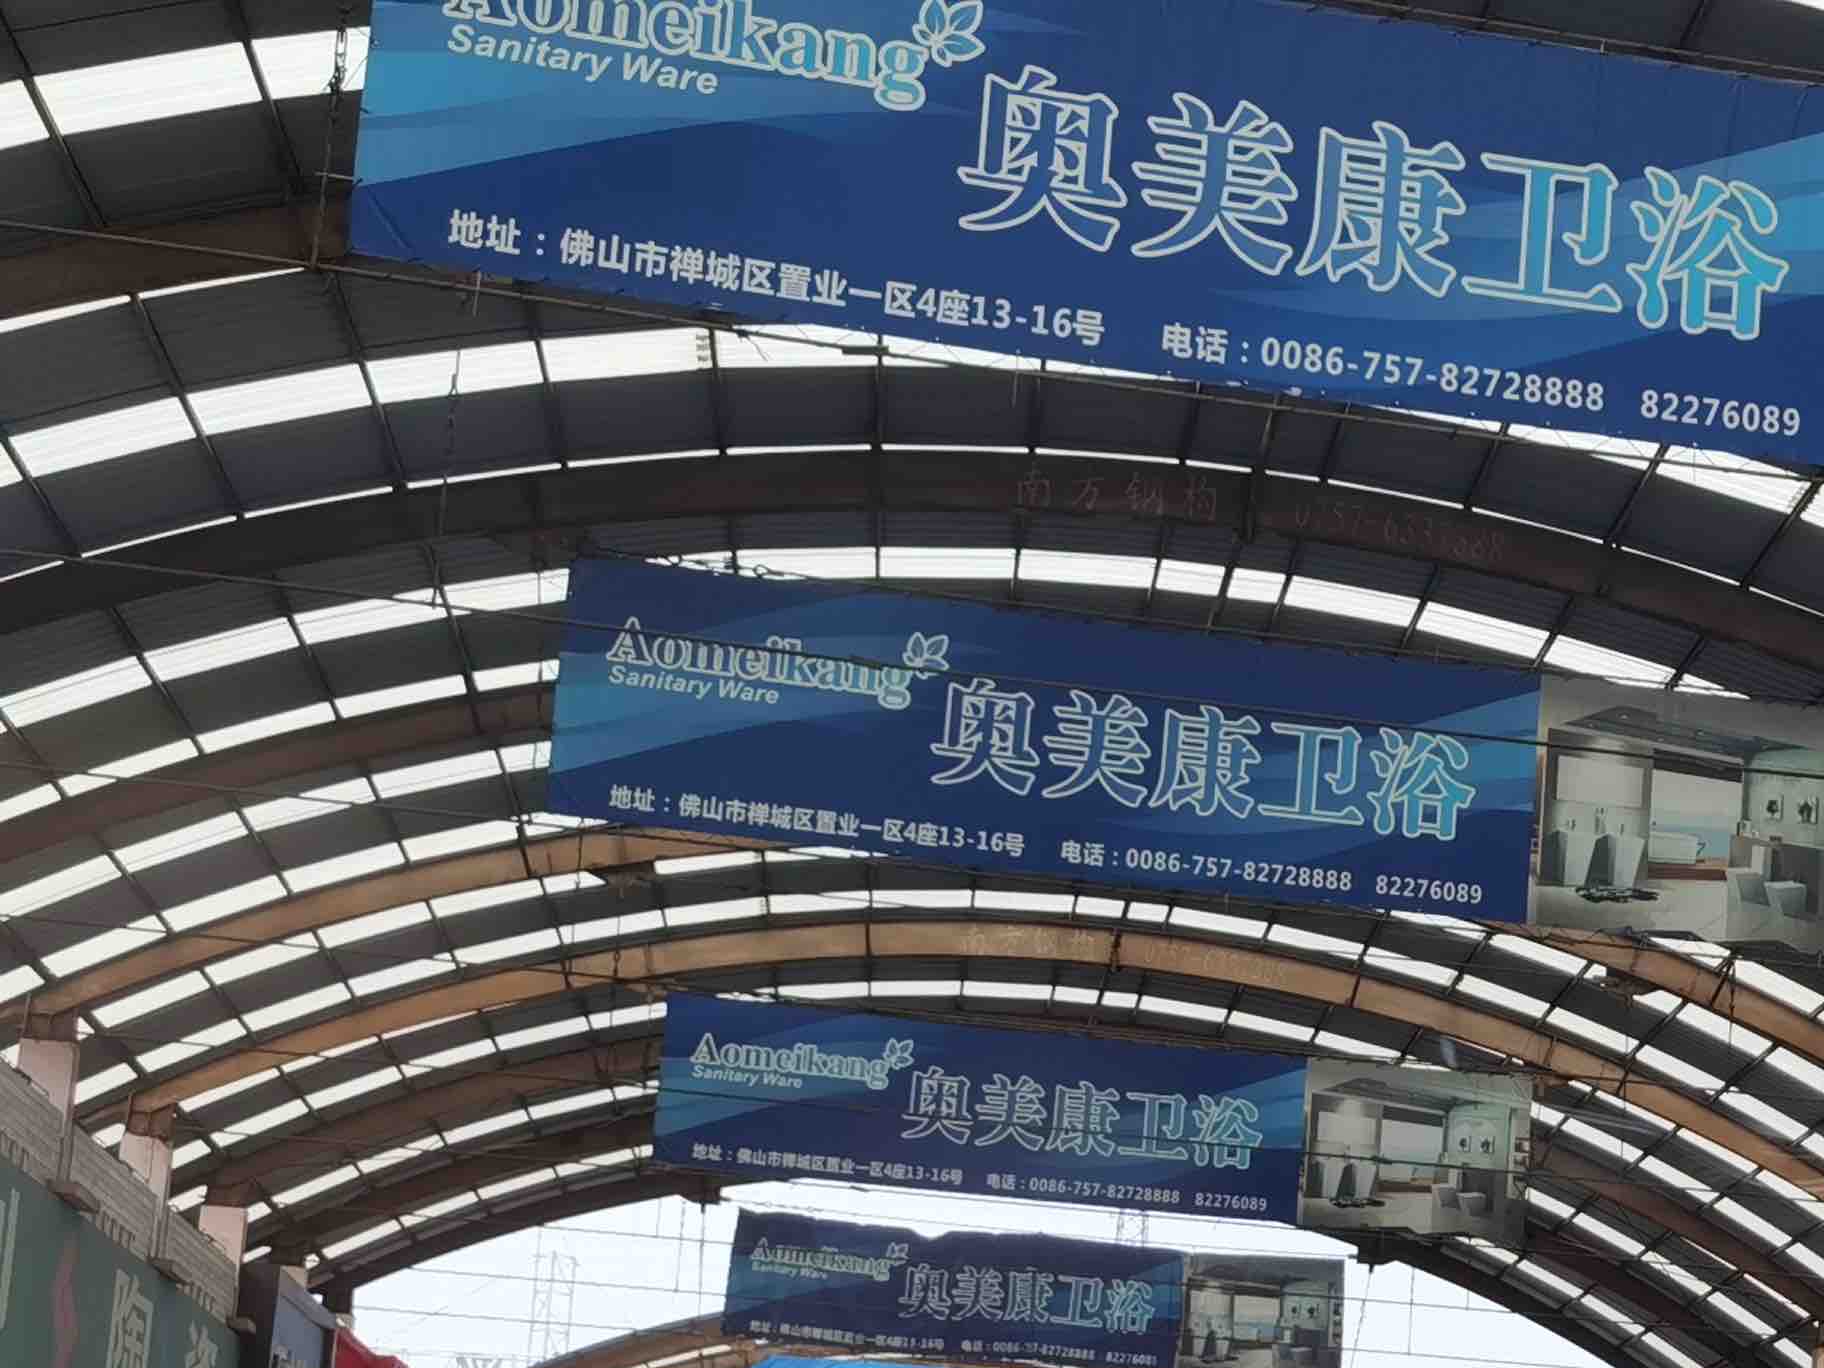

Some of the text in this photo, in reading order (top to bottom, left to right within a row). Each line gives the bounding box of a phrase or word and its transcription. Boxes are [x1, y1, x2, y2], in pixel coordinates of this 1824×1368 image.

[442, 0, 928, 111] omeikang
[446, 22, 719, 95] Sanitary Ware
[956, 64, 1791, 342] 奥美康卫浴
[447, 208, 1801, 437] 地址：佛山市禅城区置业一区4座13-16号 电话：0086-757-82728888 82276089
[605, 615, 912, 710] Aomeikang
[607, 663, 780, 705] Sanitary Ware
[930, 676, 1476, 842] 奥美康卫浴
[1060, 839, 1353, 892] 电话：0086-757-82728888
[1375, 874, 1483, 904] 82276089
[690, 1032, 890, 1090] Aomeikang
[692, 1064, 803, 1088] Sanitary Ware
[901, 1064, 1264, 1170] 奥美康卫浴
[1194, 1190, 1268, 1212] 82276089
[898, 1262, 1156, 1335] 奥美康卫浴
